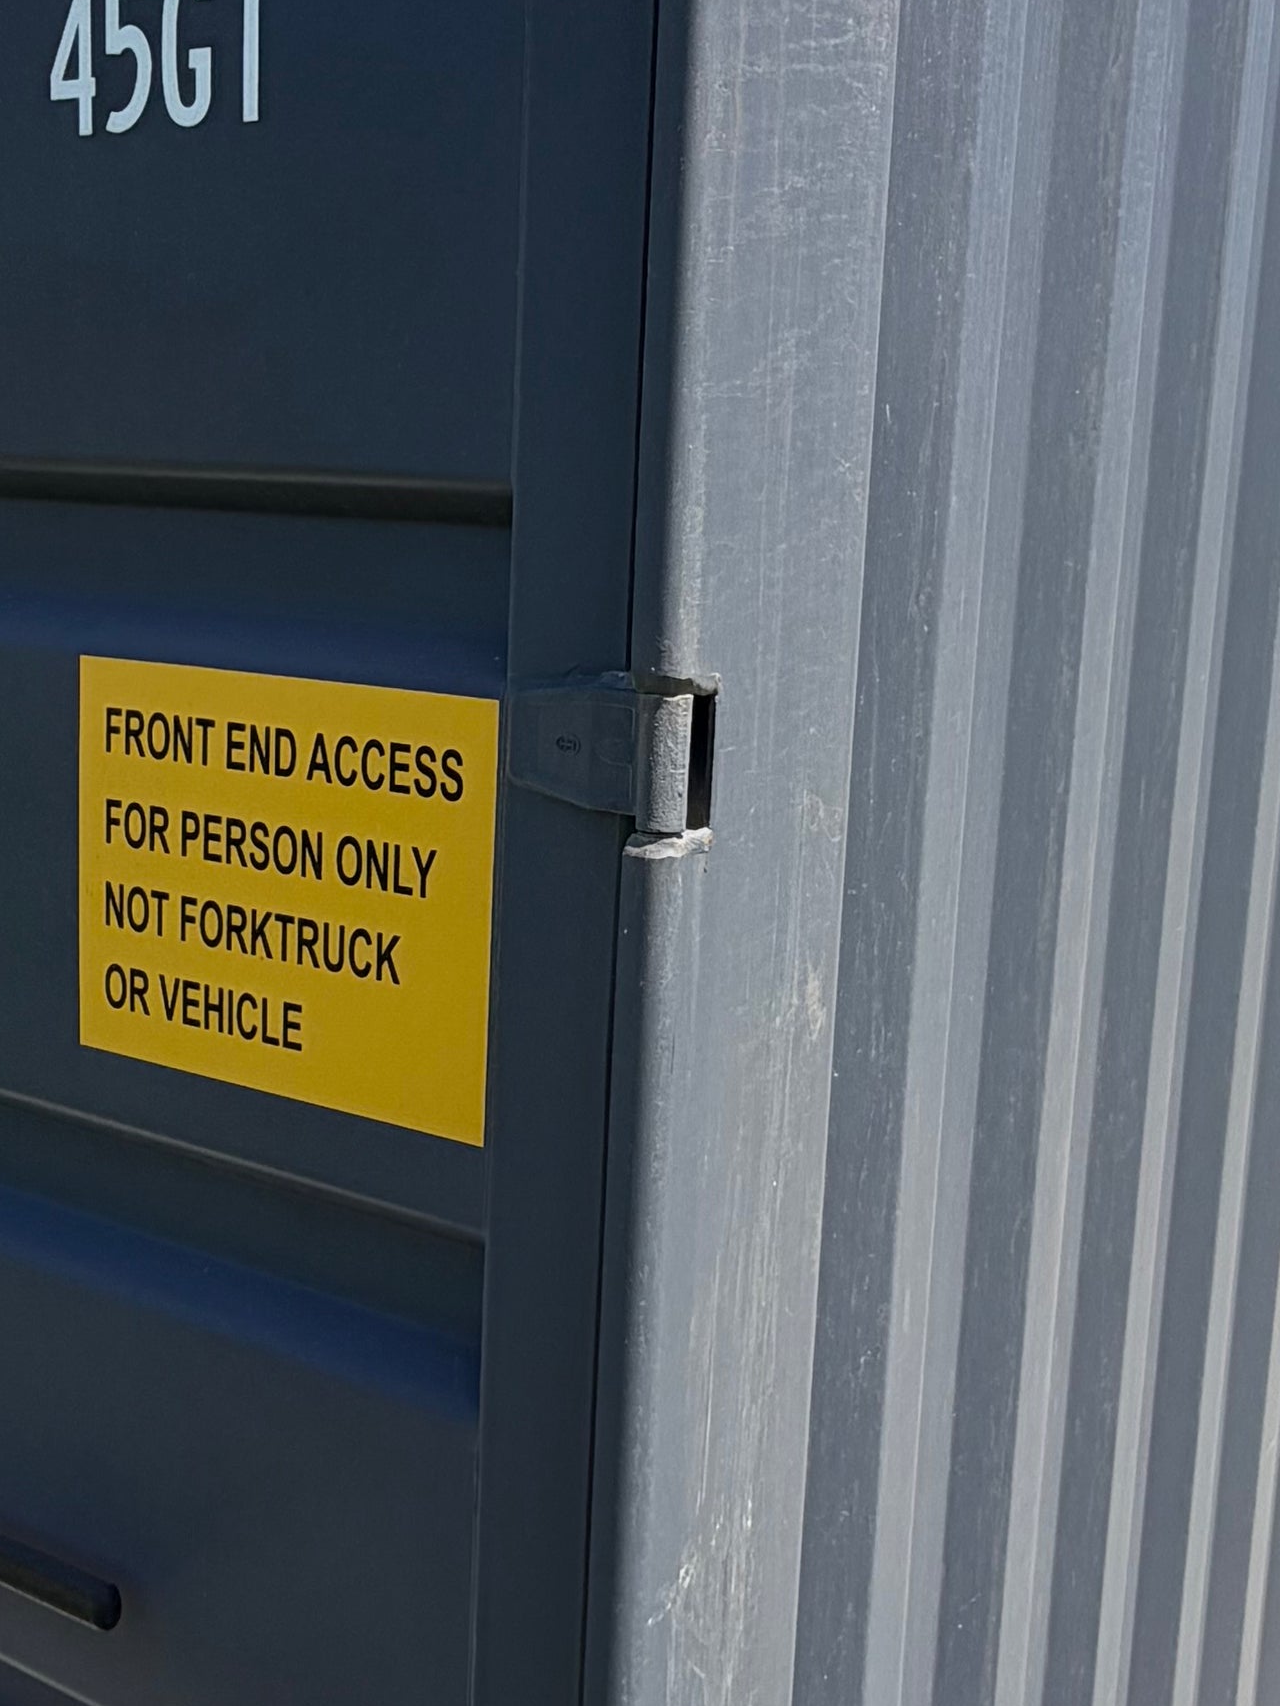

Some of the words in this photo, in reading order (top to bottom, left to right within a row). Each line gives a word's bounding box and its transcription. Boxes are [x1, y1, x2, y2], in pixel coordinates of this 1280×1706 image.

[105, 707, 216, 766] FRONT
[226, 721, 298, 777] END
[307, 732, 465, 802] ACCESS
[105, 798, 170, 854] FOR
[181, 810, 323, 881] PERSON
[336, 835, 438, 899] ONLY
[105, 881, 170, 936] NOT
[180, 896, 402, 985] FORKTRUCK
[105, 963, 150, 1017] OR
[158, 974, 303, 1051] VEHICLE
